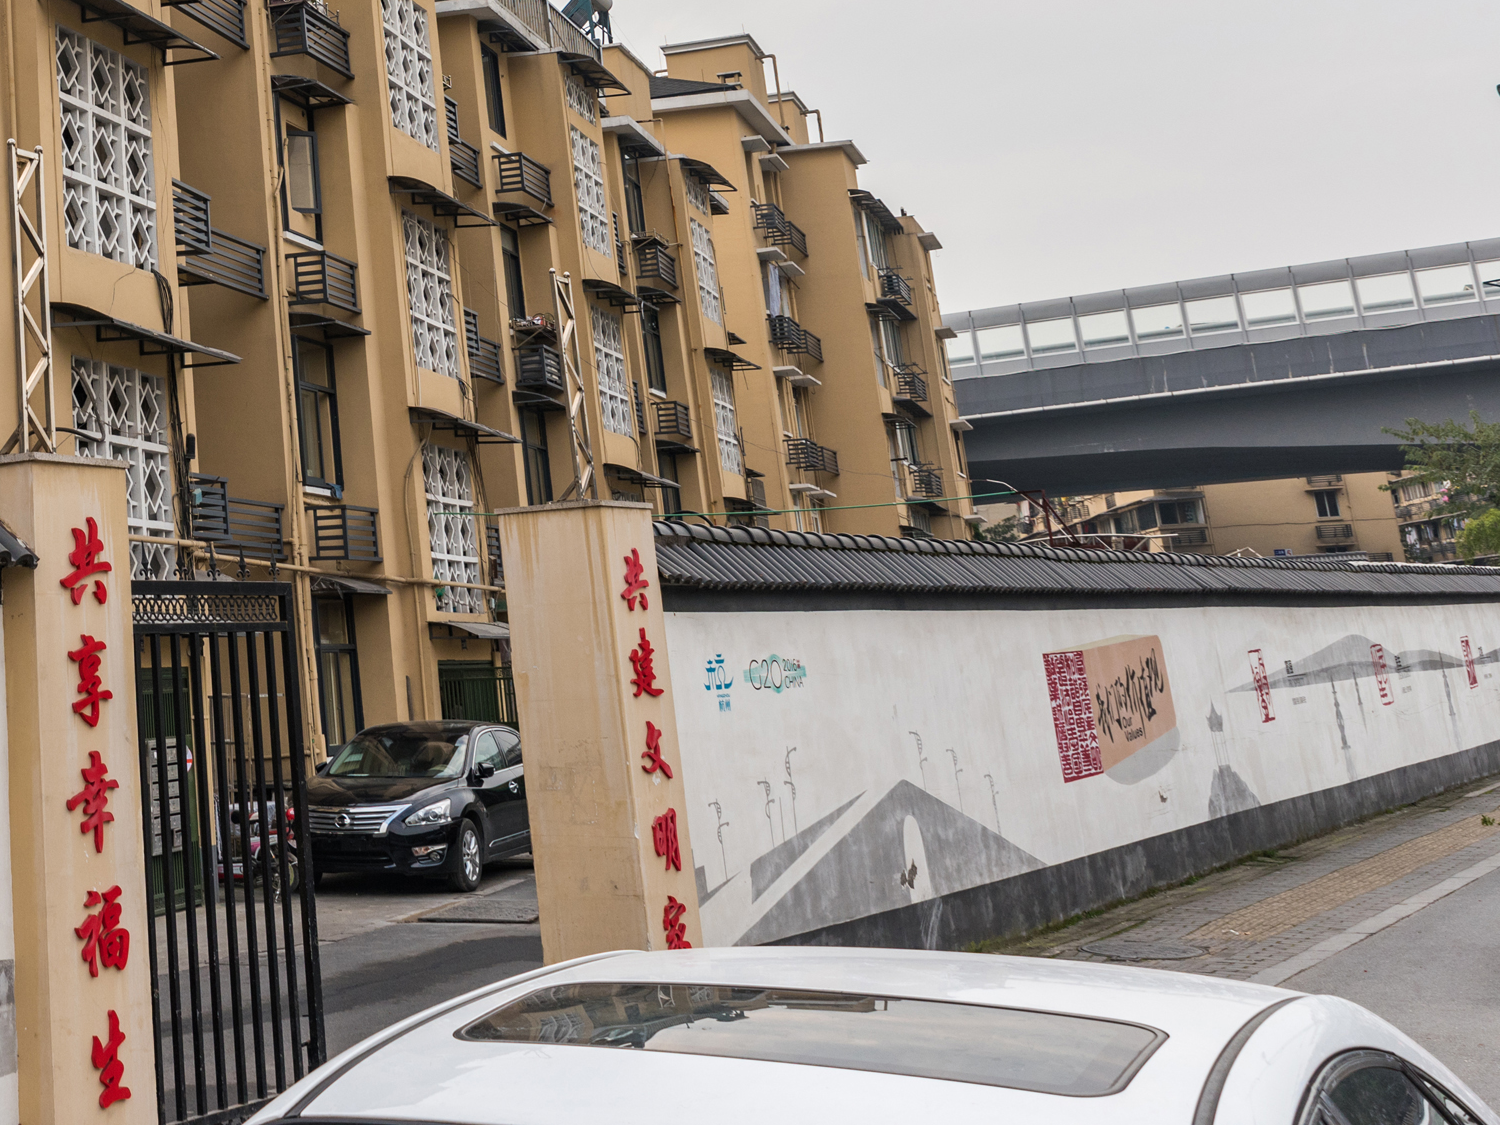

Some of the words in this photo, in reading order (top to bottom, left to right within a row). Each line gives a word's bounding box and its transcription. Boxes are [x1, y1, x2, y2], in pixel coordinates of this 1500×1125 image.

[782, 659, 798, 671] 2016
[749, 659, 783, 690] G20
[784, 675, 805, 688] CHINA
[1122, 716, 1133, 729] Our
[1124, 727, 1144, 743] Values
